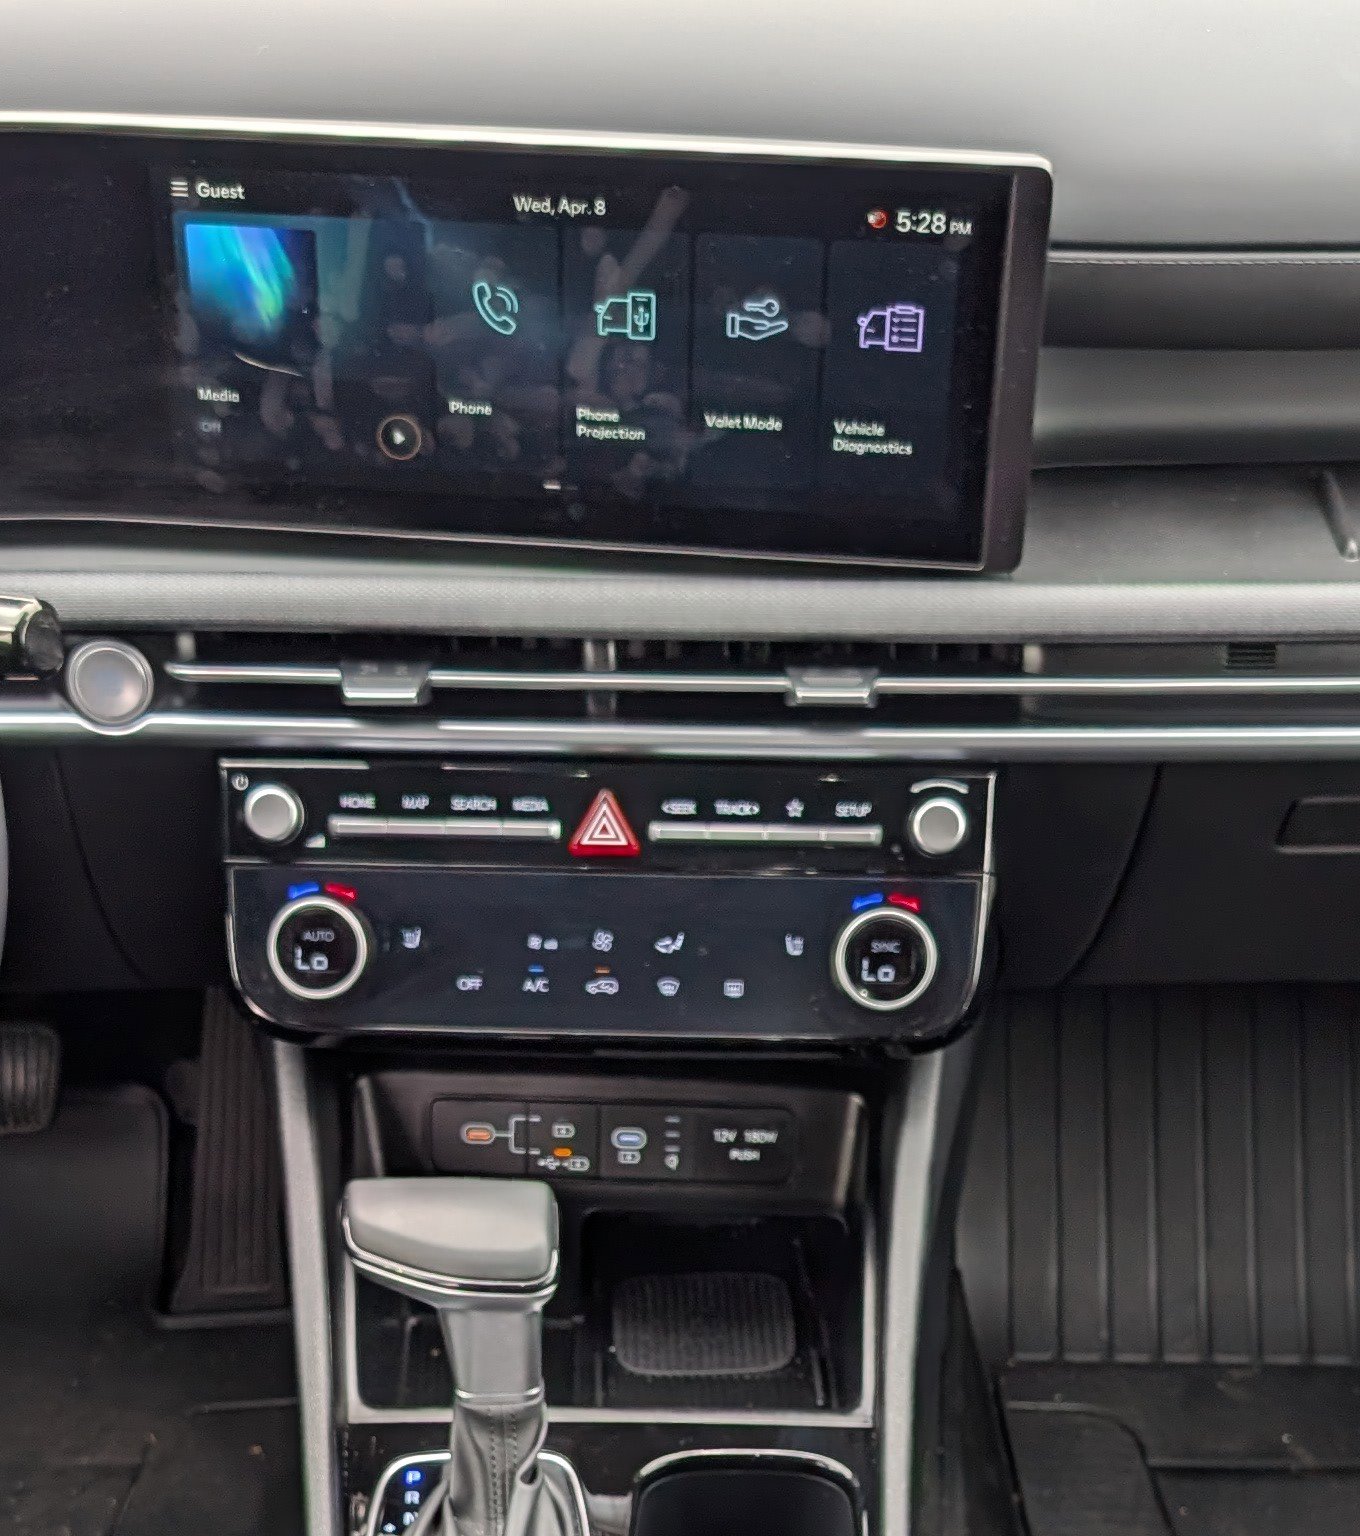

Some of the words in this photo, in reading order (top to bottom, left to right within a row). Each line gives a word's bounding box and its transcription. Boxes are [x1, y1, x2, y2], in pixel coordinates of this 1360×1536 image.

[196, 182, 245, 200] Guest
[513, 196, 555, 215] Wed,
[558, 199, 591, 217] Apr.
[593, 200, 606, 216] 8
[896, 211, 947, 235] 5:28
[949, 221, 972, 235] PM
[197, 387, 240, 403] Media
[449, 399, 492, 415] Phone
[576, 407, 620, 422] Phone
[704, 411, 741, 429] Valet
[743, 414, 782, 431] Mode
[834, 418, 885, 436] Vehicle
[576, 424, 646, 441] Projection
[833, 437, 913, 455] Diagnostics
[522, 977, 549, 993] A/C
[405, 1470, 421, 1485] P
